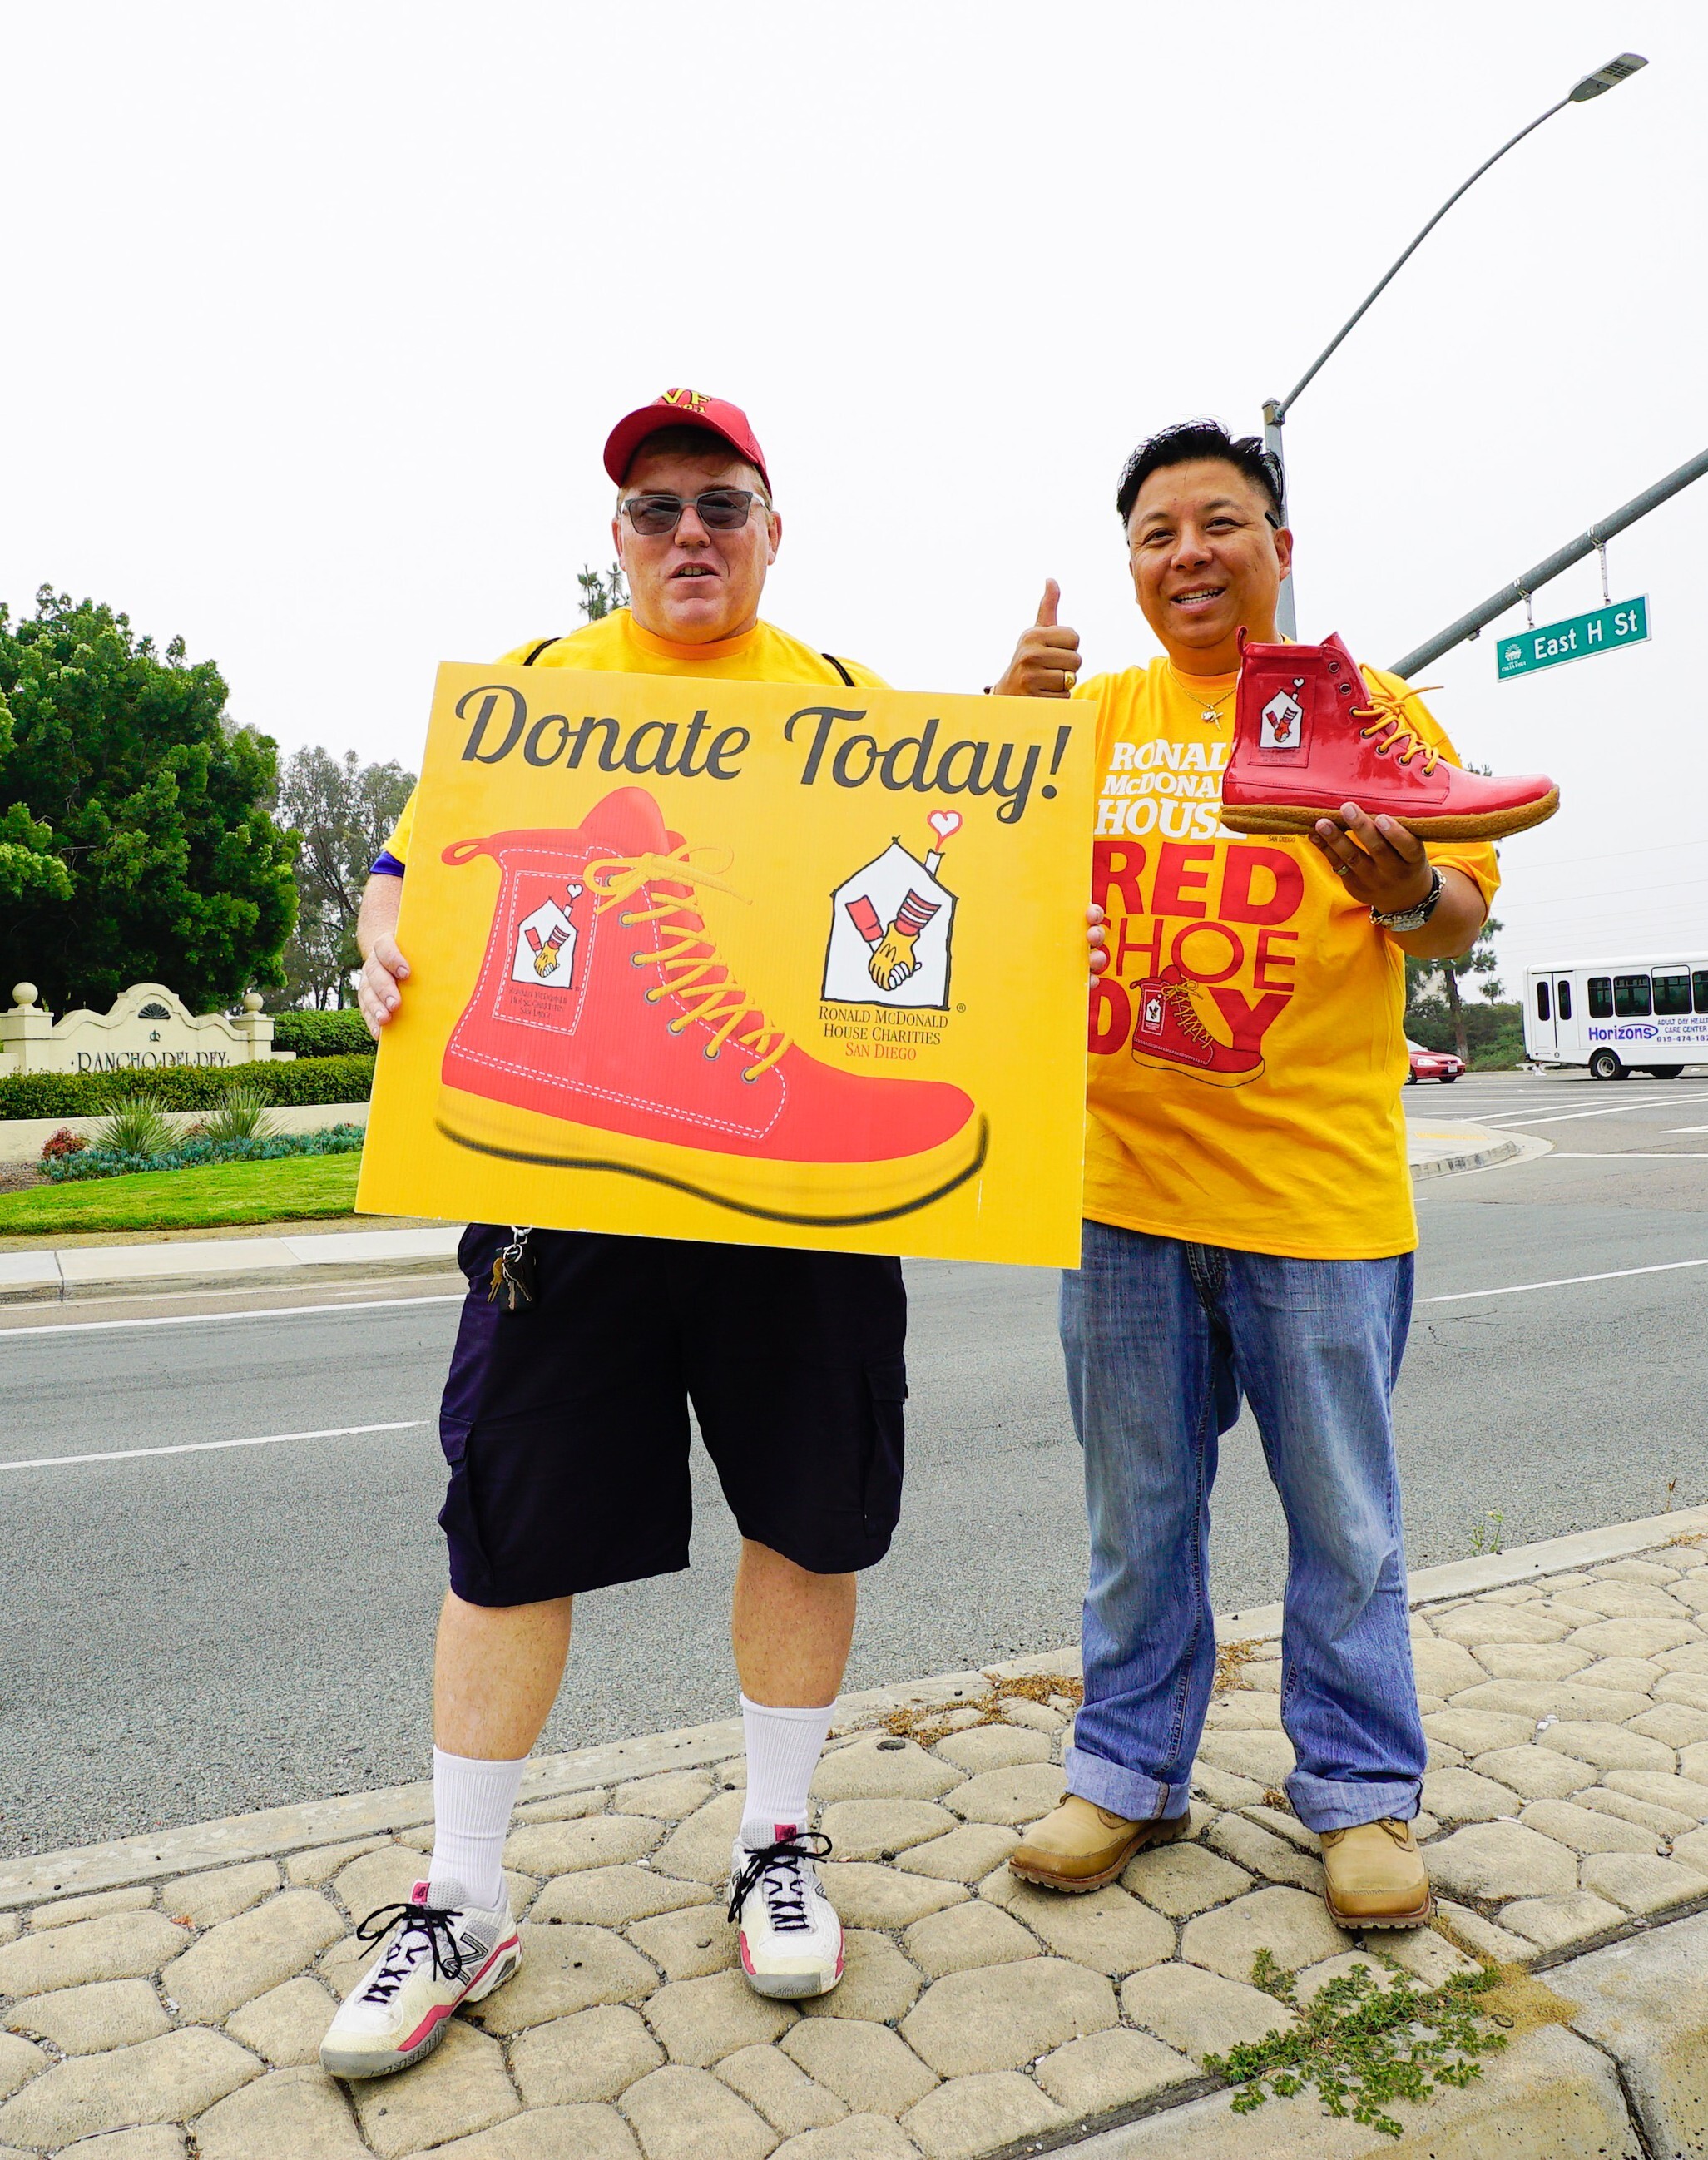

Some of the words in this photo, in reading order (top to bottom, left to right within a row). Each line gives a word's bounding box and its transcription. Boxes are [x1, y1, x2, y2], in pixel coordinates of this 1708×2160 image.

[1535, 628, 1577, 660] East
[1587, 620, 1602, 644] H
[1615, 609, 1638, 636] St
[456, 685, 750, 780] Donate
[784, 706, 1072, 824] Today!
[1109, 739, 1229, 771] RONAL
[1101, 771, 1224, 799] McDONA
[1092, 840, 1304, 925] RED
[819, 1006, 871, 1023] RONALD
[824, 1023, 868, 1040] HOUSE
[872, 1026, 941, 1045] CHARITIES
[1588, 1025, 1652, 1041] Horizons
[845, 1042, 870, 1058] SAN
[874, 1043, 916, 1061] DIEGO
